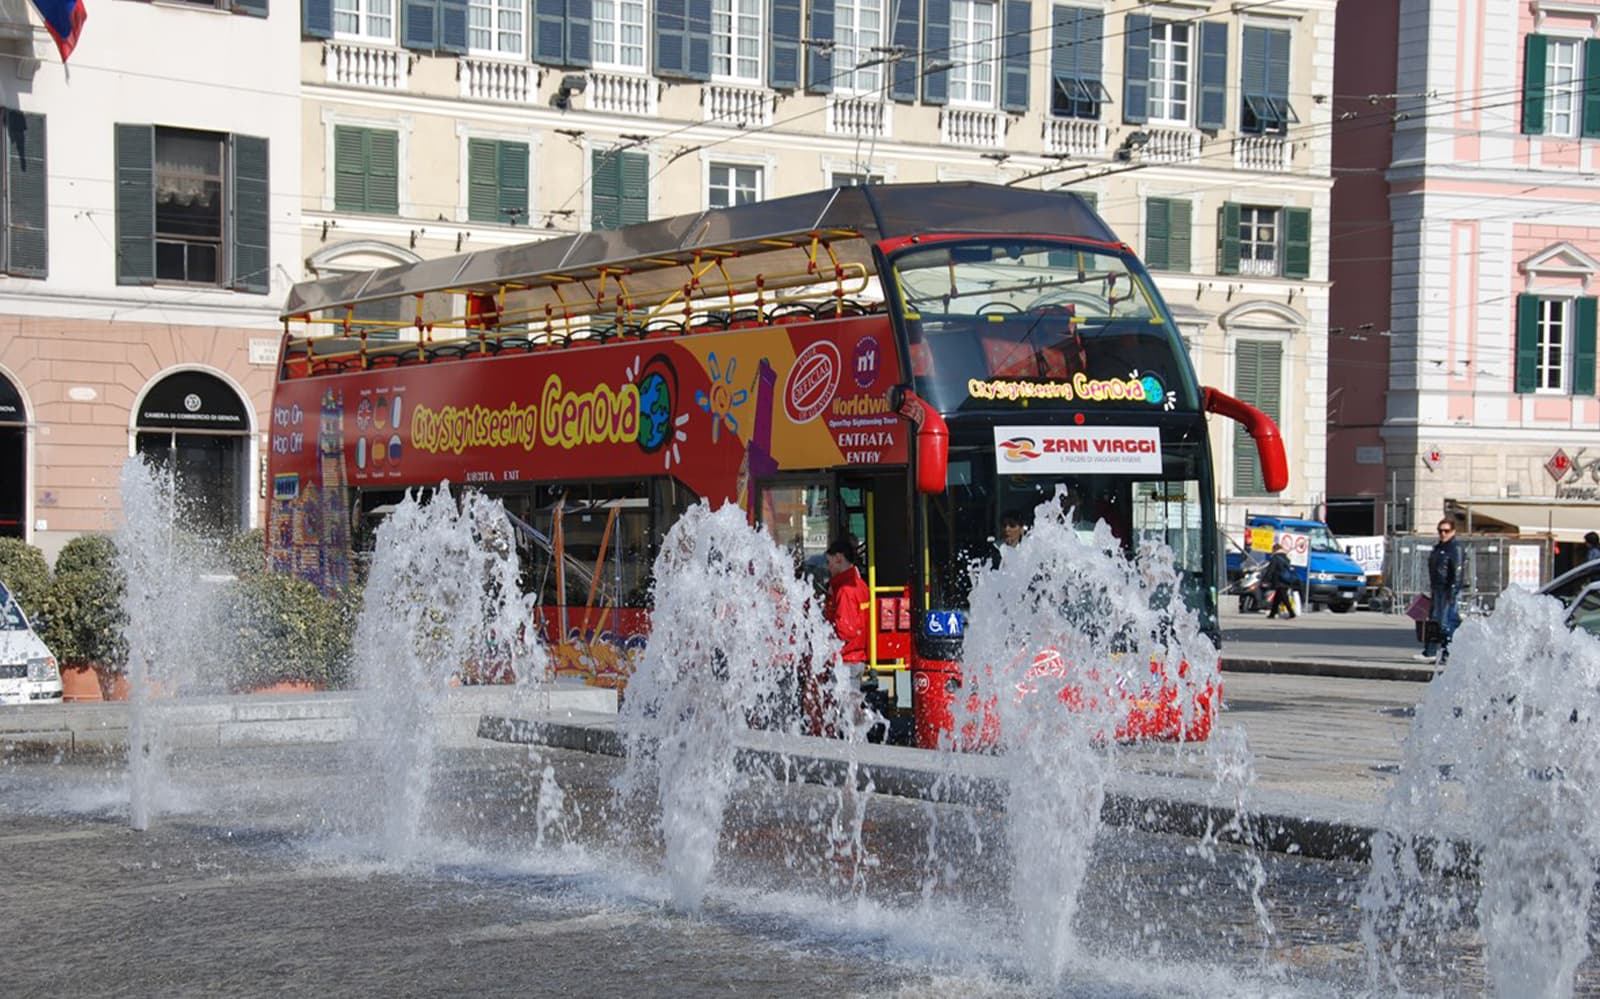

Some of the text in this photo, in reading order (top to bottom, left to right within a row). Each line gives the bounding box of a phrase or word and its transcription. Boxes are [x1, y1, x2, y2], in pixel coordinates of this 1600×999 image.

[1073, 372, 1145, 401] Genova
[144, 411, 169, 419] CAMERA
[273, 404, 304, 427] Hop On
[541, 374, 640, 449] Genova
[272, 431, 304, 455] Hop Off
[838, 432, 895, 447] ENTRATA
[1042, 438, 1156, 453] ZANI VIAGGI
[847, 451, 881, 464] ENTRY
